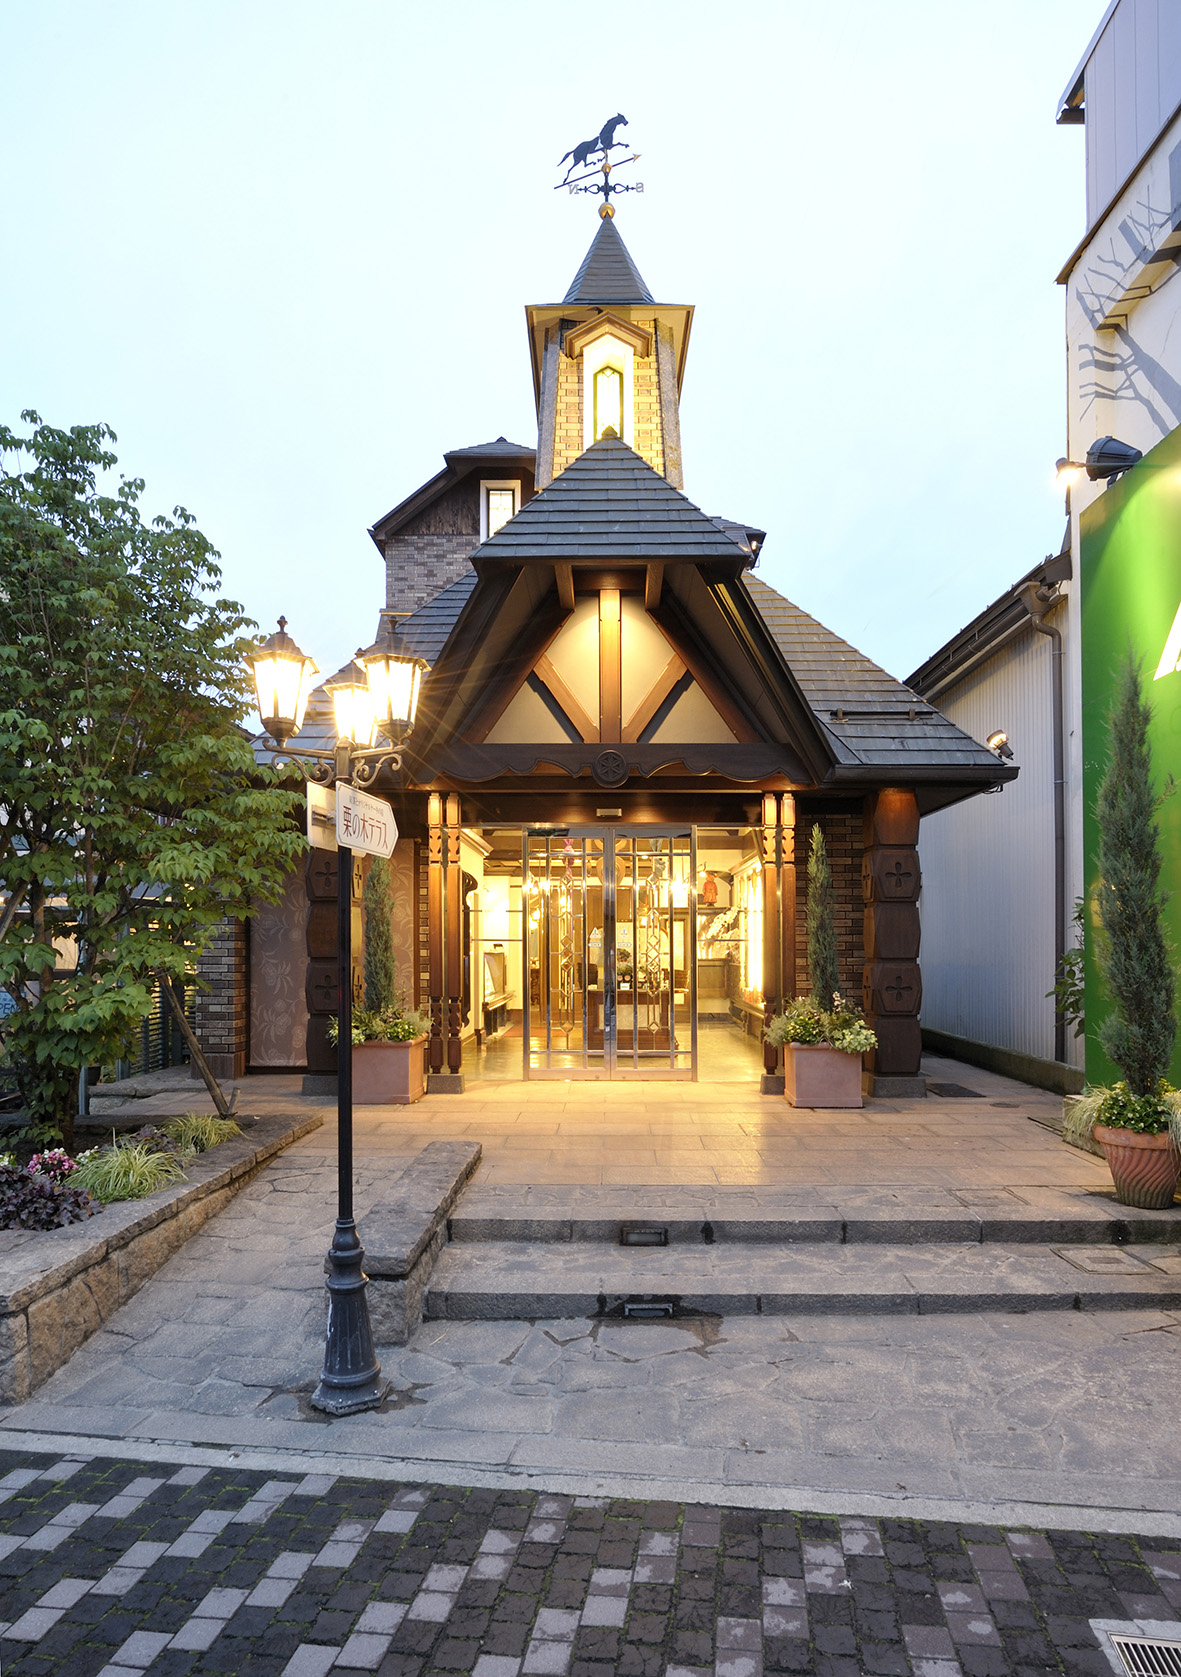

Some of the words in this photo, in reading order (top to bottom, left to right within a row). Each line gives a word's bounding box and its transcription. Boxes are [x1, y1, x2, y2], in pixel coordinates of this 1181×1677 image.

[343, 805, 388, 849] 栗の木テラス
